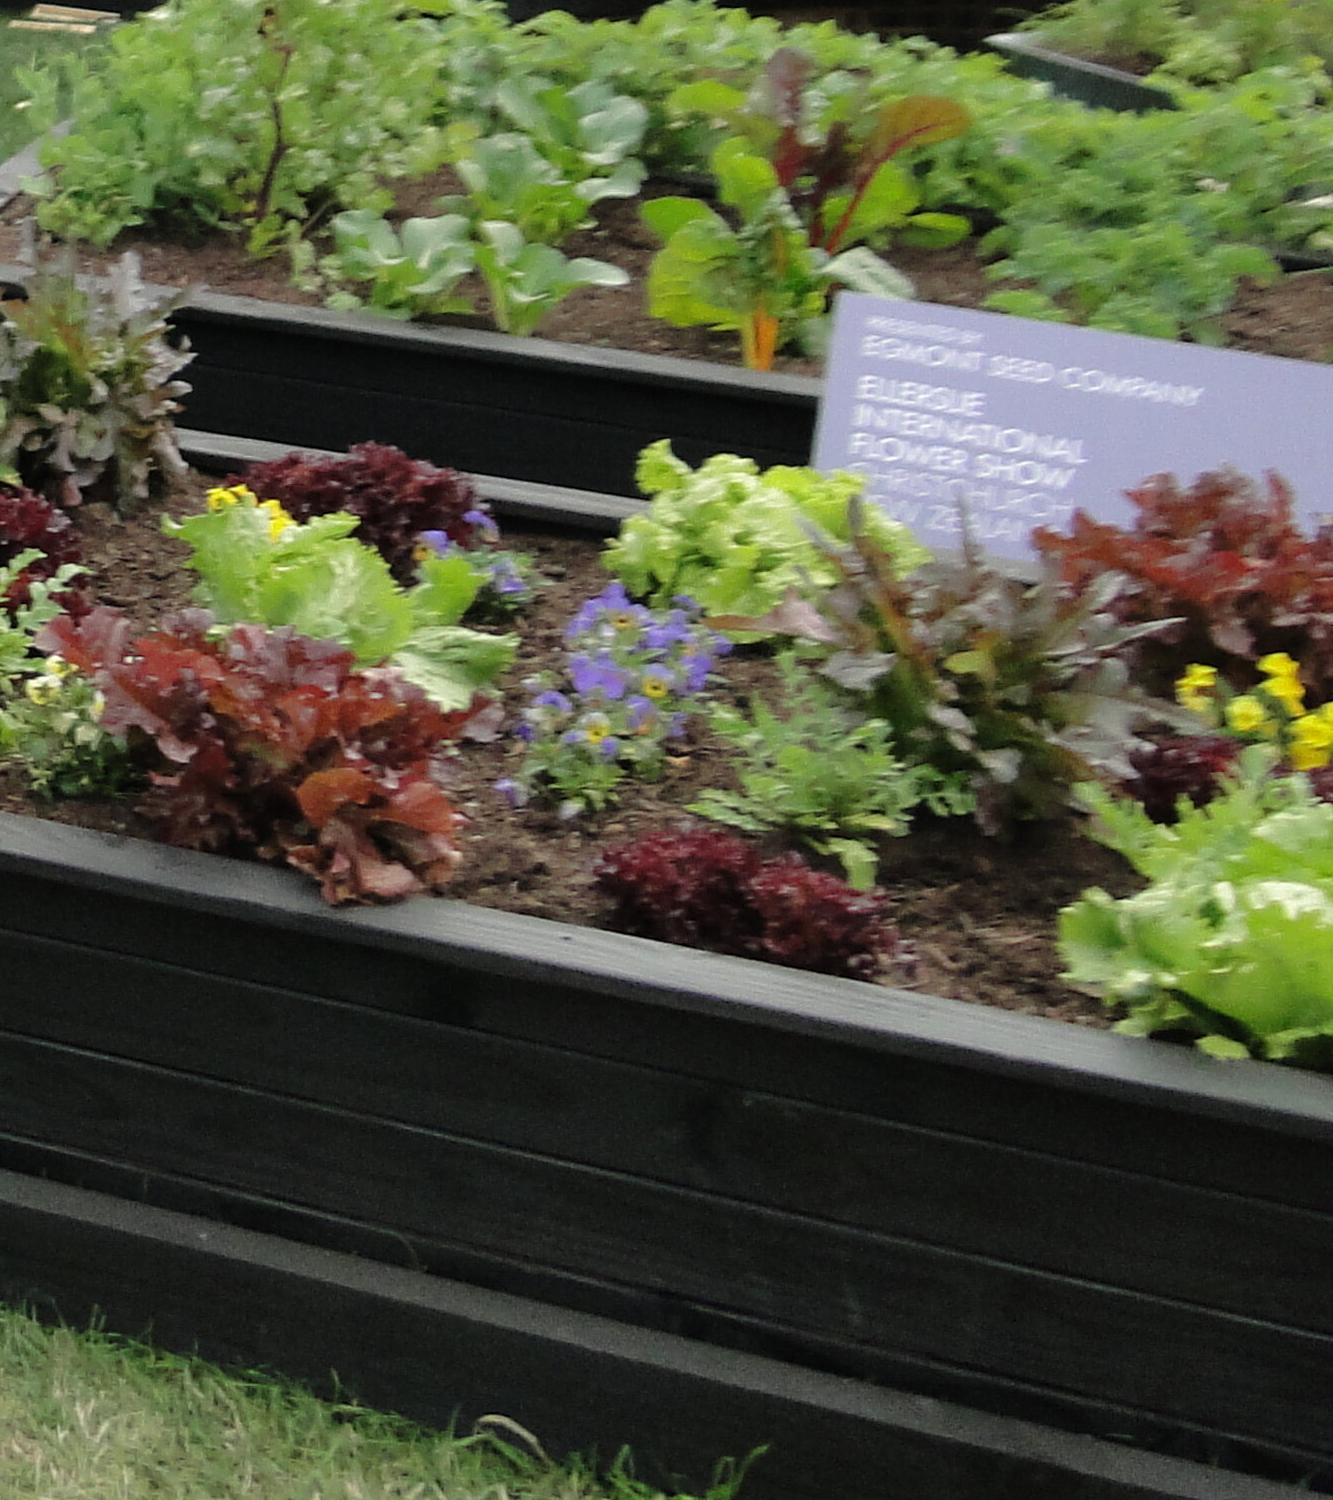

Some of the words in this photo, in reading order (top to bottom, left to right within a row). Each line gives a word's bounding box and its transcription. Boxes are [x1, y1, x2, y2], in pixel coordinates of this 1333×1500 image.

[856, 375, 986, 417] ELLERSLIE
[862, 334, 985, 373] EGMONT
[988, 355, 1055, 383] SEED
[1057, 367, 1205, 407] COMPANY
[848, 432, 968, 473] FLOWER
[975, 453, 1077, 489] SHOW
[852, 403, 1087, 465] INTERNATIONAL
